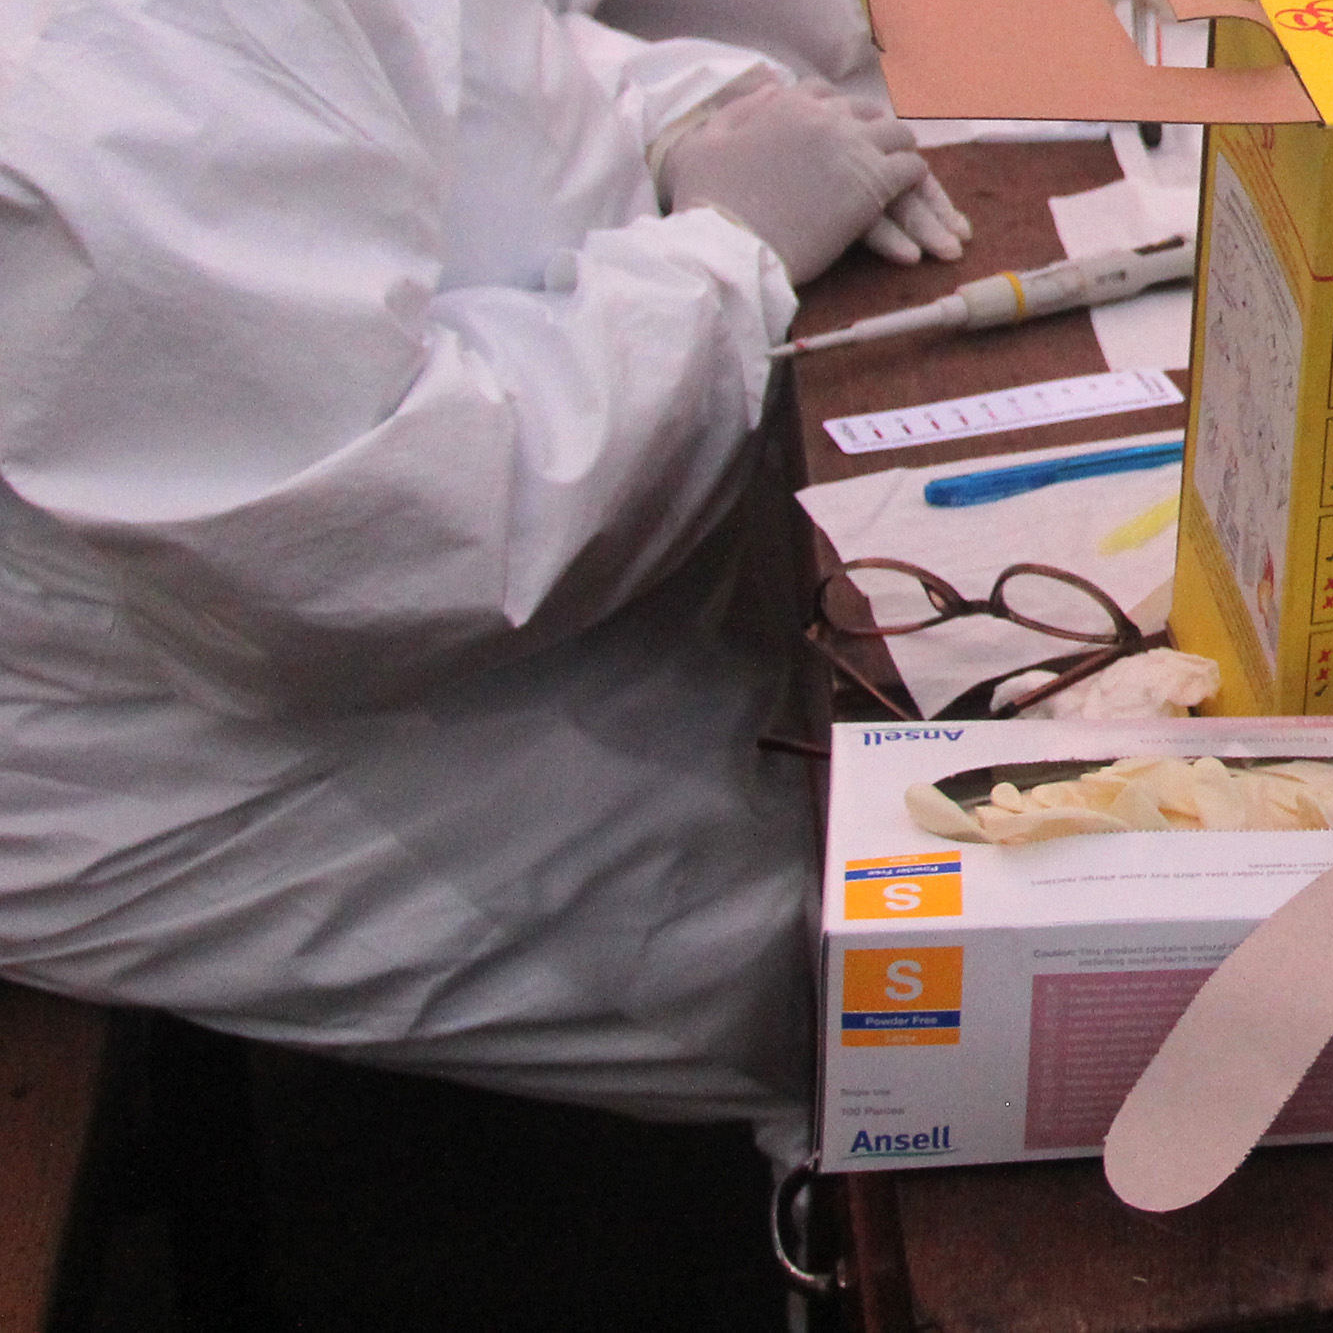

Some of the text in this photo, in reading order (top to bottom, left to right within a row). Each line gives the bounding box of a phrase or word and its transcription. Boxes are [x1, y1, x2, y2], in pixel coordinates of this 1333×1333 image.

[862, 729, 964, 746] Ansell
[866, 865, 937, 876] Powder Free
[882, 881, 922, 910] S
[884, 957, 924, 1003] S
[864, 1013, 938, 1029] Powder Free
[849, 1125, 952, 1153] Ansell
